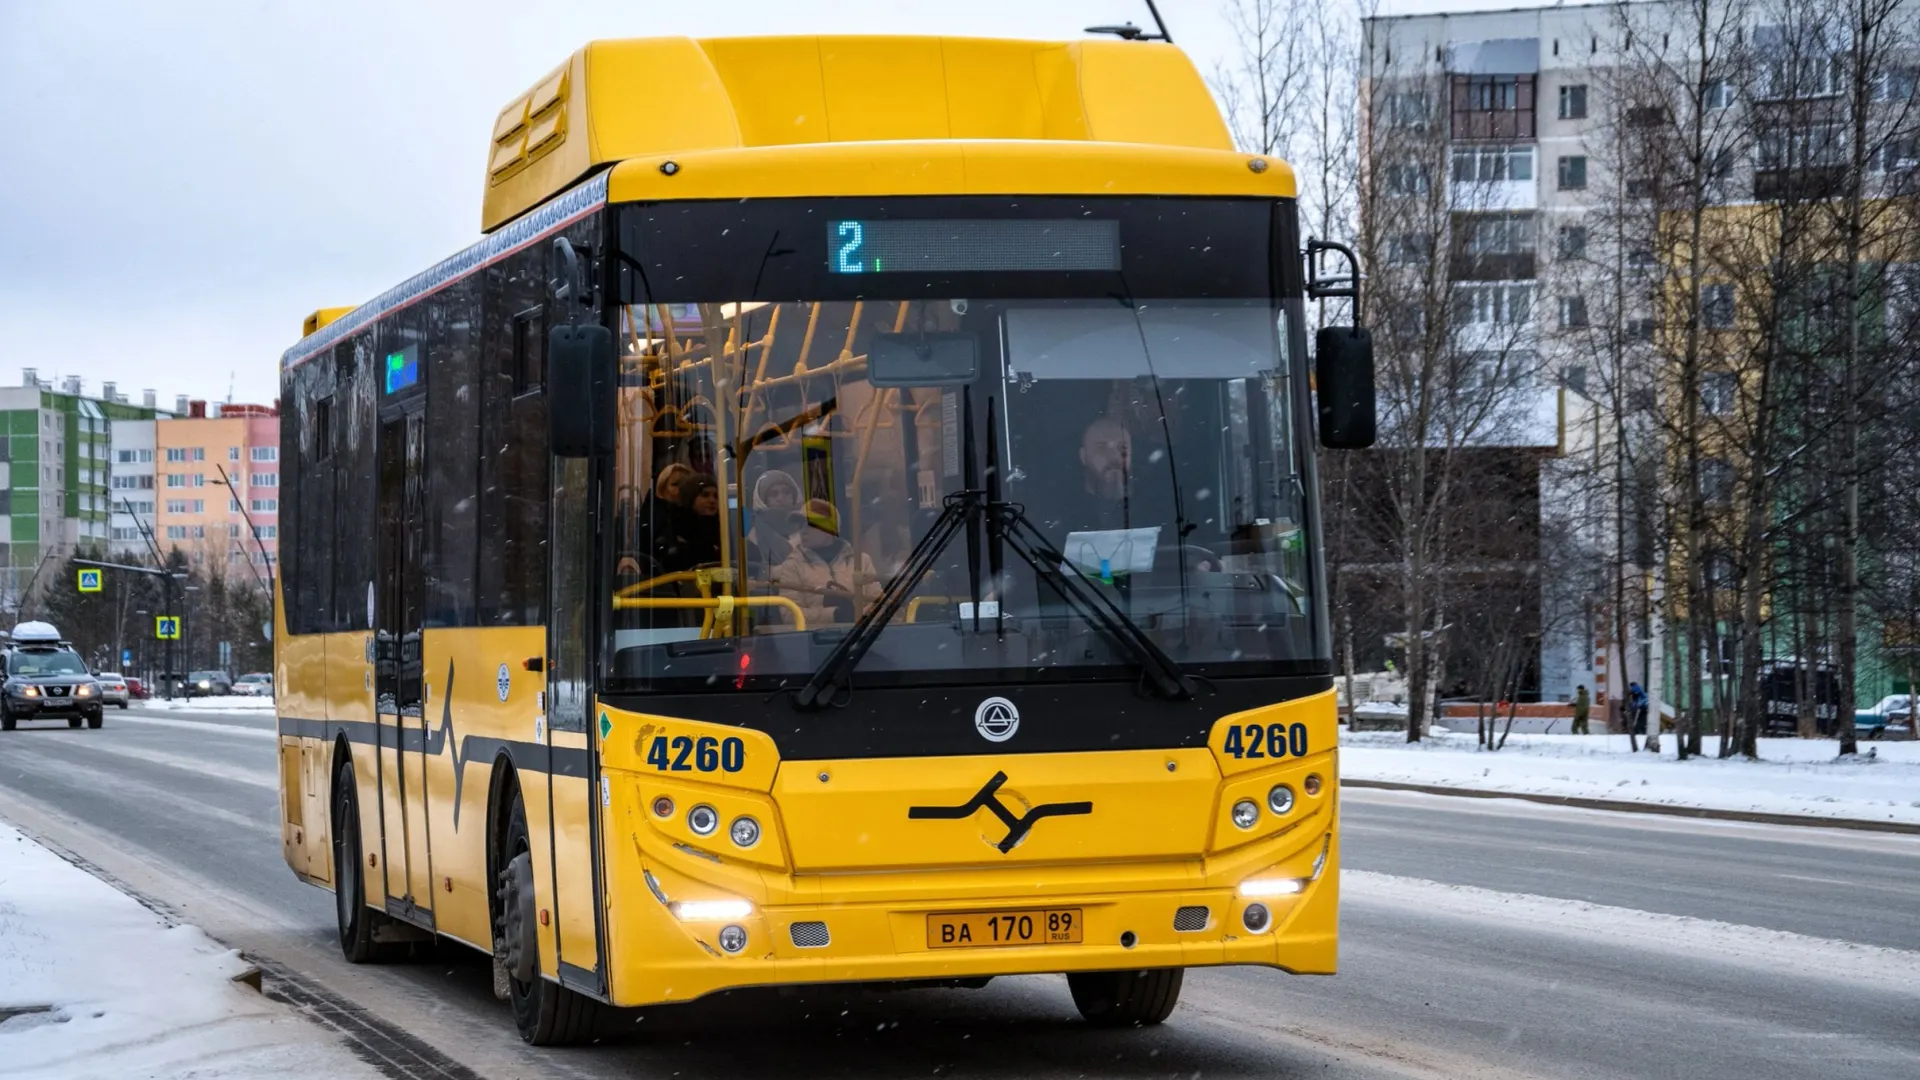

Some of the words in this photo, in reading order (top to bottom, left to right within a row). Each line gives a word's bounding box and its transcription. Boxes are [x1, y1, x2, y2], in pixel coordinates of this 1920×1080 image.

[839, 221, 862, 272] 2
[647, 736, 744, 772] 4260
[1224, 722, 1308, 758] 4260
[988, 916, 1033, 942] 170
[1048, 913, 1072, 932] 89
